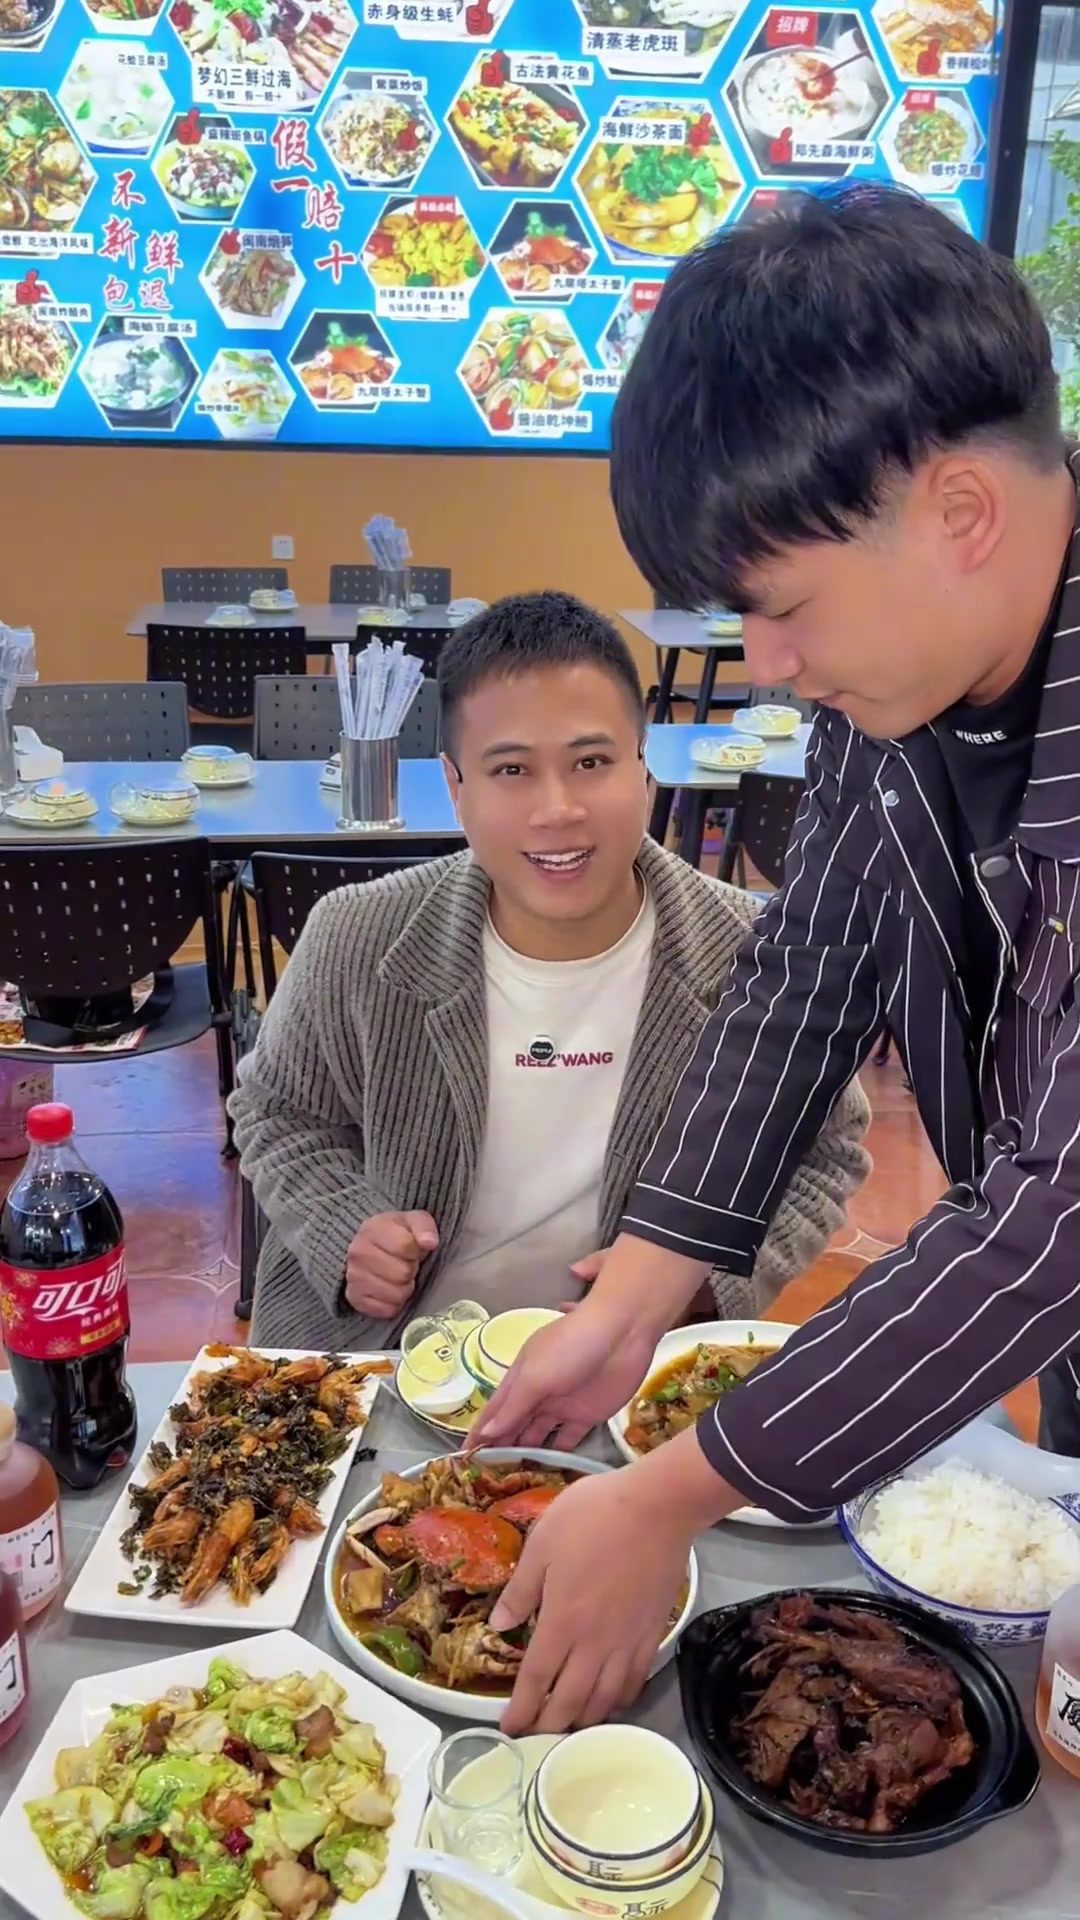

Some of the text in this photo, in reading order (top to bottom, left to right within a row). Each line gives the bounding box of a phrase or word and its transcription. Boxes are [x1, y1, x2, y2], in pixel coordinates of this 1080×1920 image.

[367, 3, 453, 22] 赤身级生蚝
[776, 15, 810, 35] 招牌
[197, 66, 291, 88] 梦幻三鲜过海
[515, 64, 590, 81] 古法黄花鱼
[375, 78, 423, 92] 紫菜炒饭
[602, 121, 684, 141] 海鲜沙茶面
[582, 374, 625, 388] 爆炒鱿
[32, 1255, 126, 1319] 可口可
